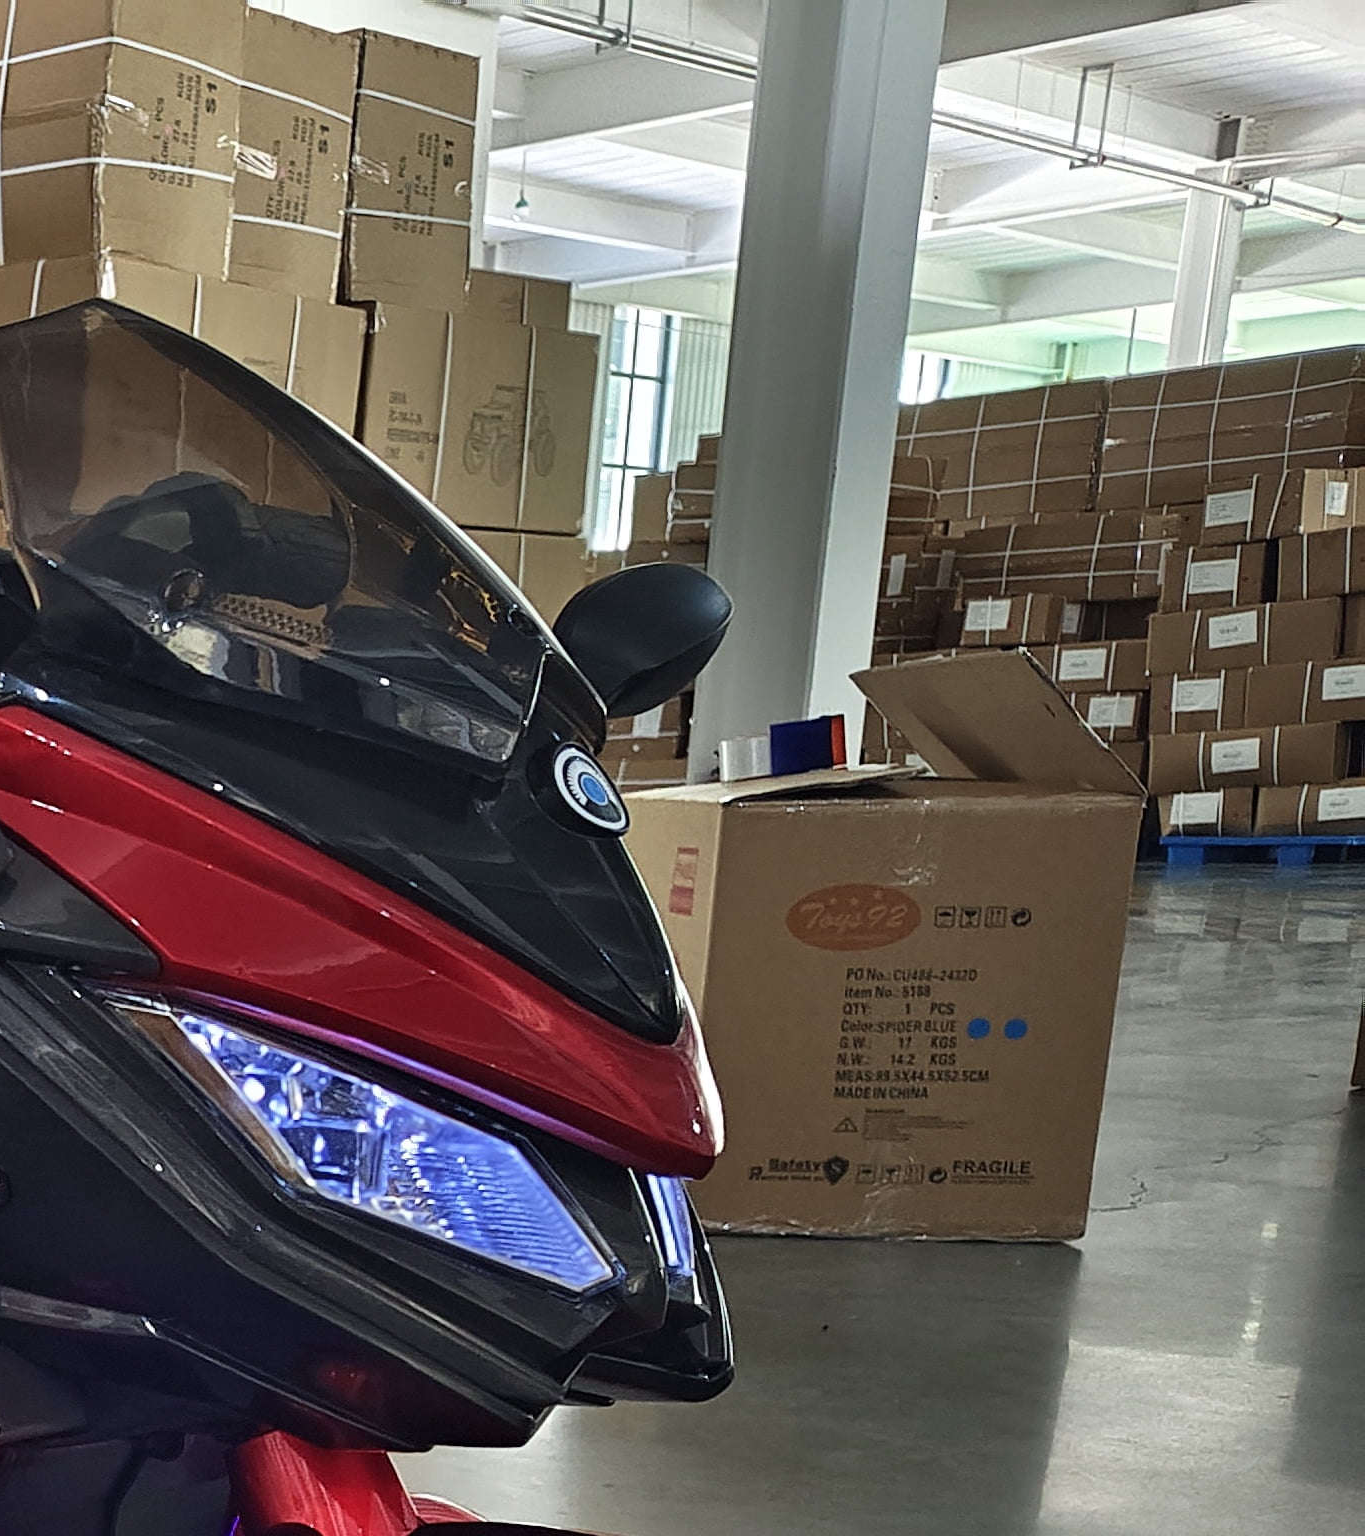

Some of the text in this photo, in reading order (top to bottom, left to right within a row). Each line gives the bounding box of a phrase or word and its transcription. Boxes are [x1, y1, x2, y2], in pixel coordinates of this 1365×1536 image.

[205, 82, 217, 114] S1
[317, 124, 330, 154] S1
[442, 139, 454, 168] S1
[800, 902, 908, 934] Toys 92
[846, 968, 864, 981] PO
[845, 986, 872, 998] Item
[904, 1003, 911, 1015] 1
[929, 1002, 955, 1015] PCS
[924, 1020, 956, 1032] BLUE
[930, 1037, 957, 1049] KGS
[929, 1053, 956, 1065] KGS
[889, 1087, 928, 1099] CHINA
[952, 1159, 1031, 1176] FRAGILE
